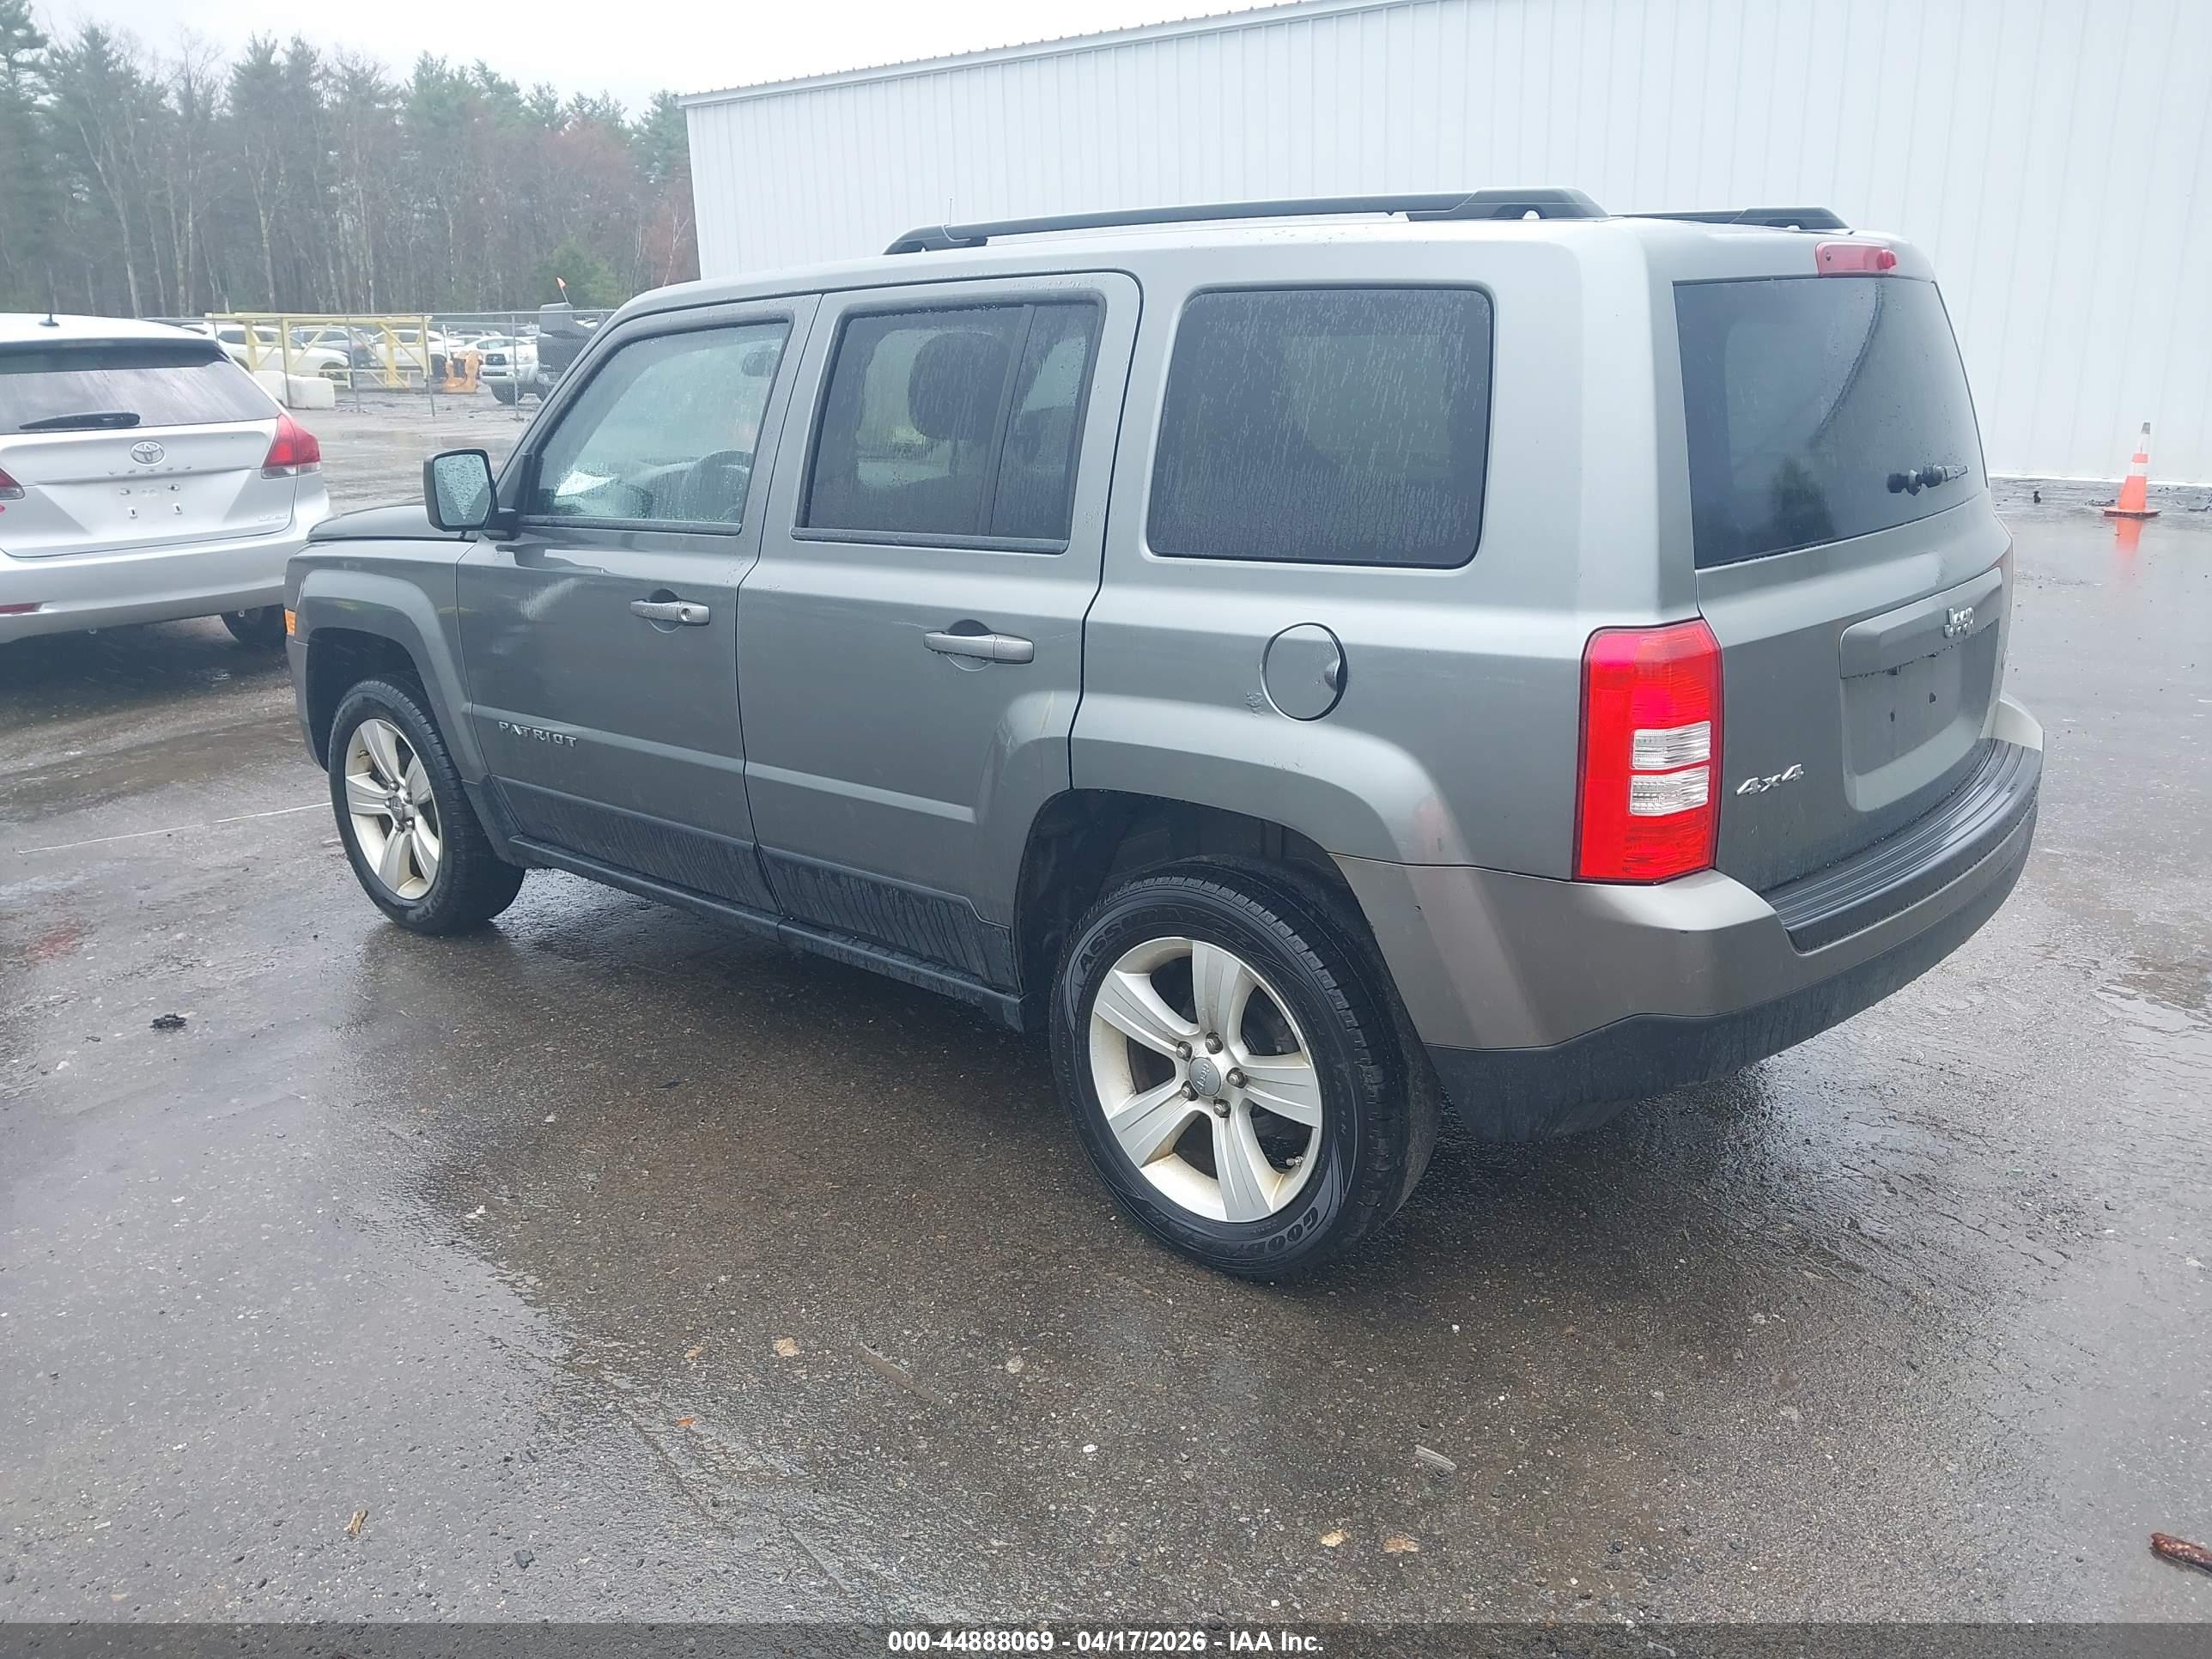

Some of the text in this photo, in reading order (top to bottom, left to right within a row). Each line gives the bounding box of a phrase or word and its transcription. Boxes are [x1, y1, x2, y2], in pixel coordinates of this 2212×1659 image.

[1944, 606, 1974, 638] Jeep
[498, 720, 578, 747] PATRIOT
[1736, 763, 1804, 795] 4x4
